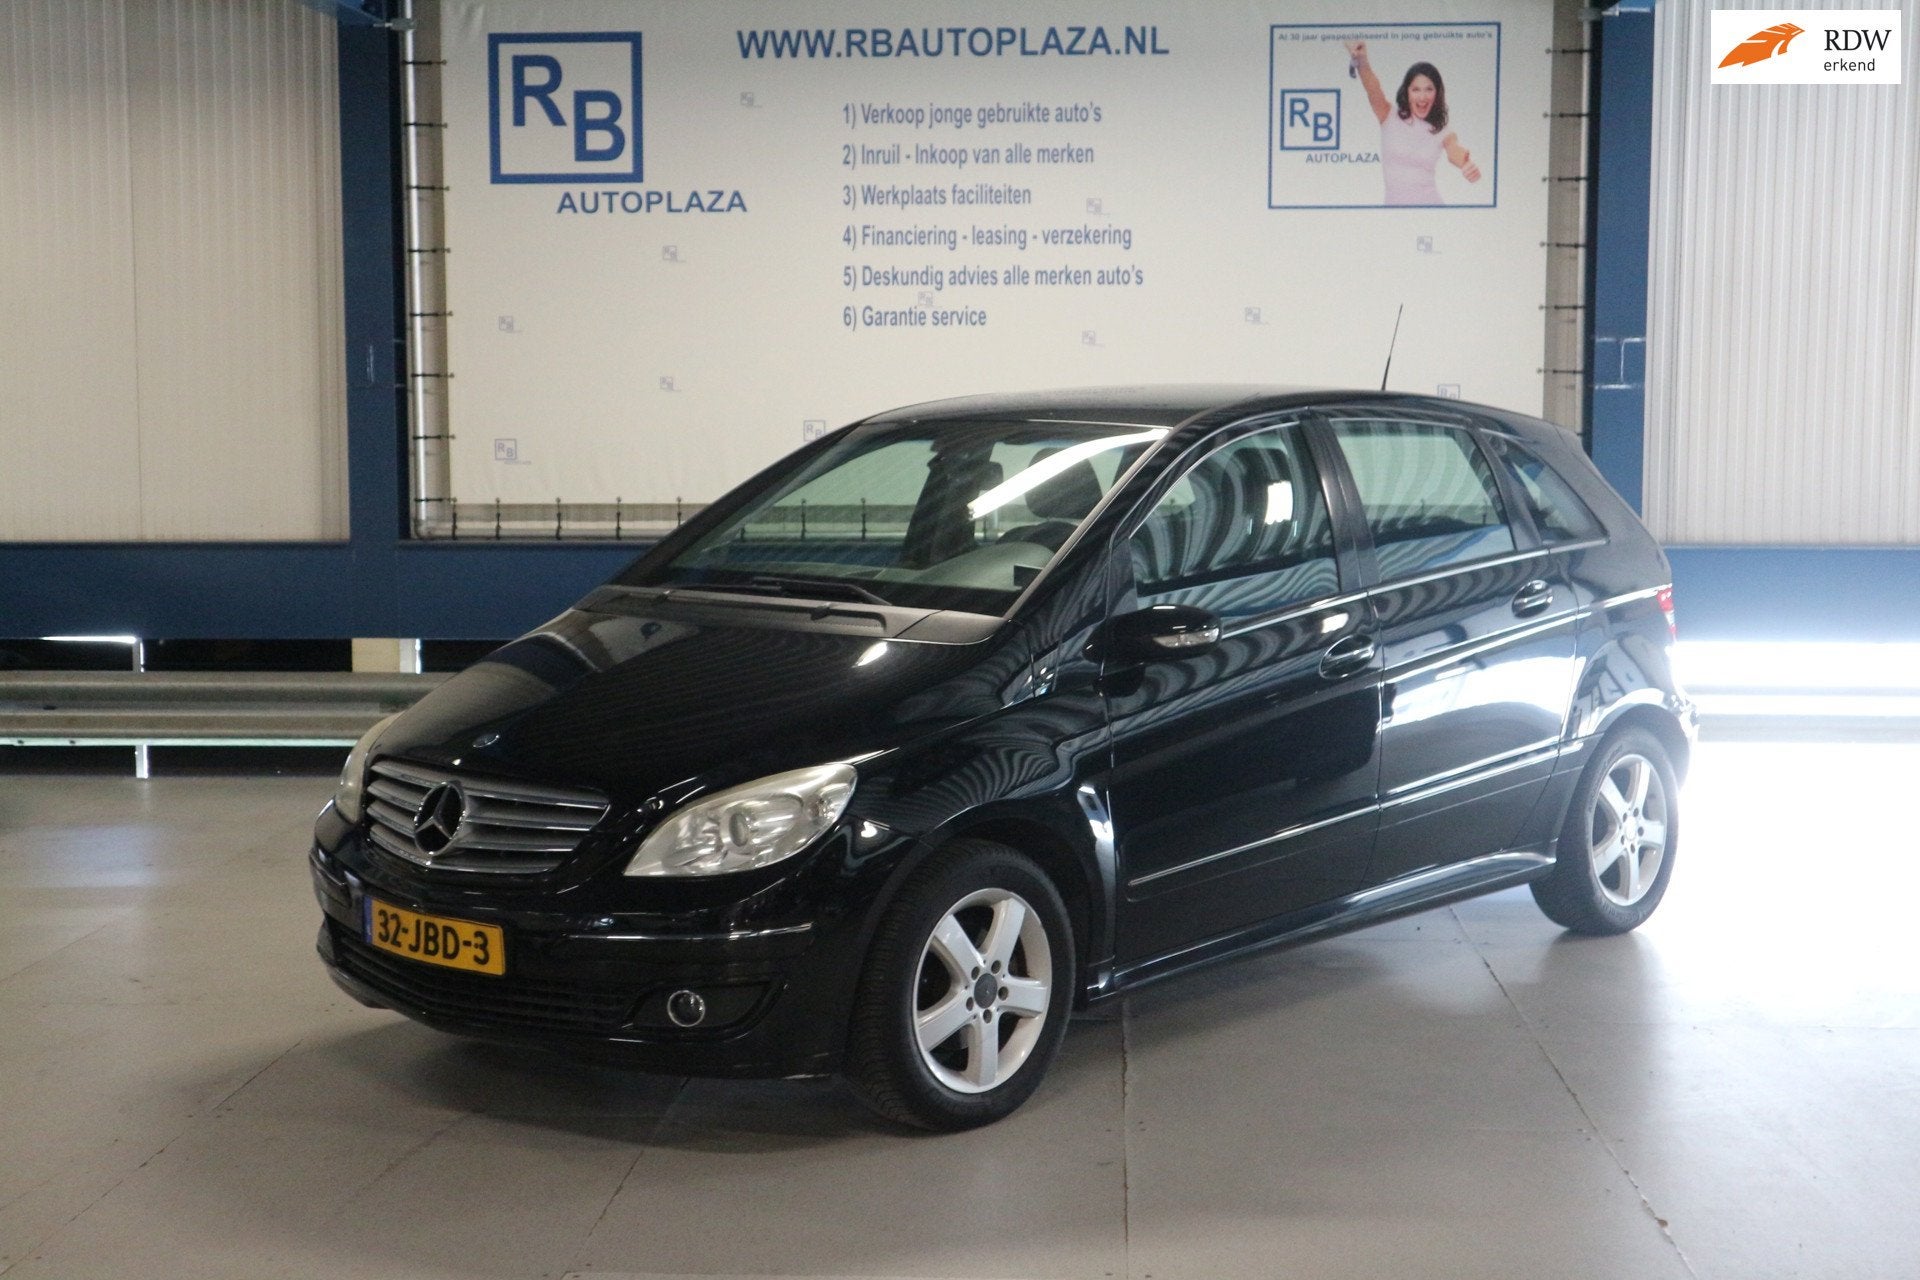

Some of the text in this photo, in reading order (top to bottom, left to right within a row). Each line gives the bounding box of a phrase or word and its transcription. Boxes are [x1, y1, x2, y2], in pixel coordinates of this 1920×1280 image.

[737, 26, 1170, 59] WWW.RBAUTOPLAZA.NL
[842, 102, 856, 130] 1)
[861, 102, 925, 129] Verkoop
[928, 102, 973, 129] jonge
[977, 101, 1050, 129] gebruikte
[842, 143, 856, 170] 2)
[861, 143, 900, 164] Inruil
[915, 142, 968, 169] Inkoop
[972, 147, 1000, 164] van
[1005, 142, 1032, 164] alle
[1036, 142, 1094, 163] merken
[1305, 152, 1380, 164] AUTOPLAZA
[556, 190, 748, 215] AUTOPLAZA
[842, 182, 1032, 211] 3) Werkplaats faciliteiten
[842, 225, 857, 251] 4)
[861, 224, 957, 251] Financiering
[972, 224, 1027, 250] leasing
[1042, 223, 1133, 250] verzekering
[843, 265, 857, 292] 5)
[862, 264, 944, 291] Deskundig
[948, 264, 999, 286] advies
[1003, 264, 1030, 285] alle
[1034, 264, 1093, 285] merken
[843, 305, 987, 332] 6) Garantie service
[377, 909, 490, 966] 32-JBD-3
